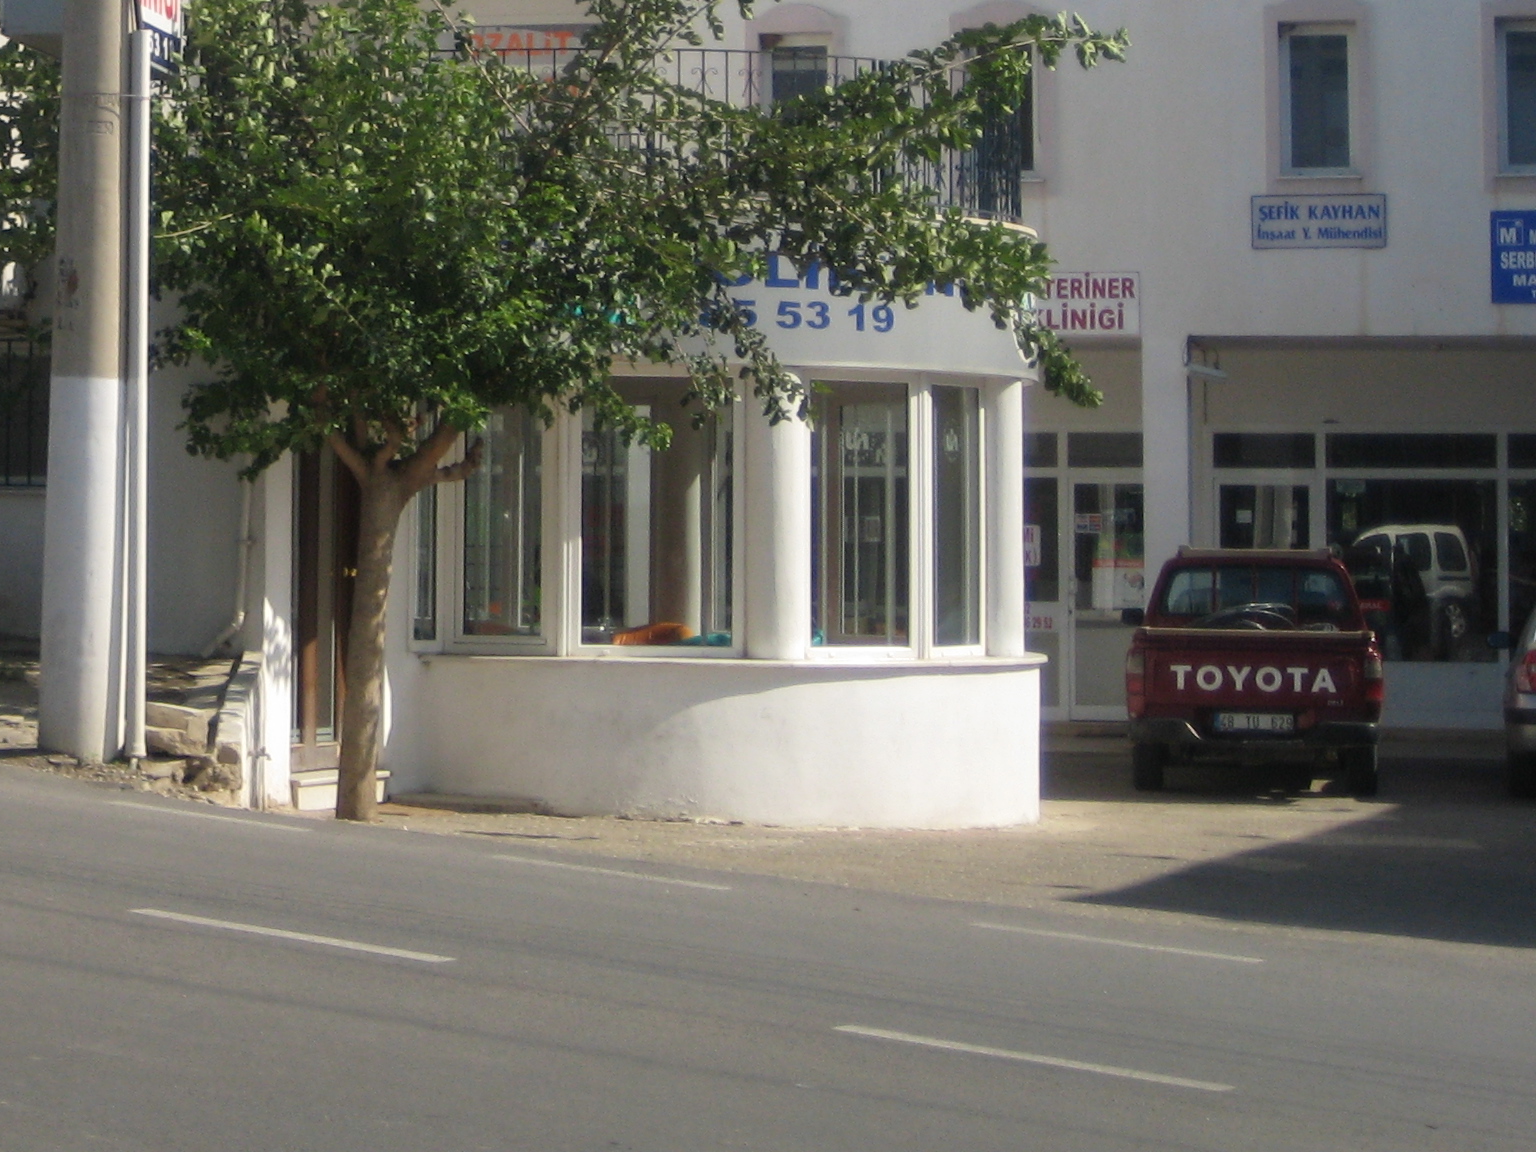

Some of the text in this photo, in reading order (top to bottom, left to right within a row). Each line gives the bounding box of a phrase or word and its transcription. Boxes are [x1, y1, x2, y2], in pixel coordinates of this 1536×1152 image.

[1308, 205, 1380, 220] KAYHAN
[1500, 251, 1536, 270] SERB
[775, 300, 831, 330] 53
[848, 302, 895, 333] 19
[1170, 664, 1337, 693] TOYOTA
